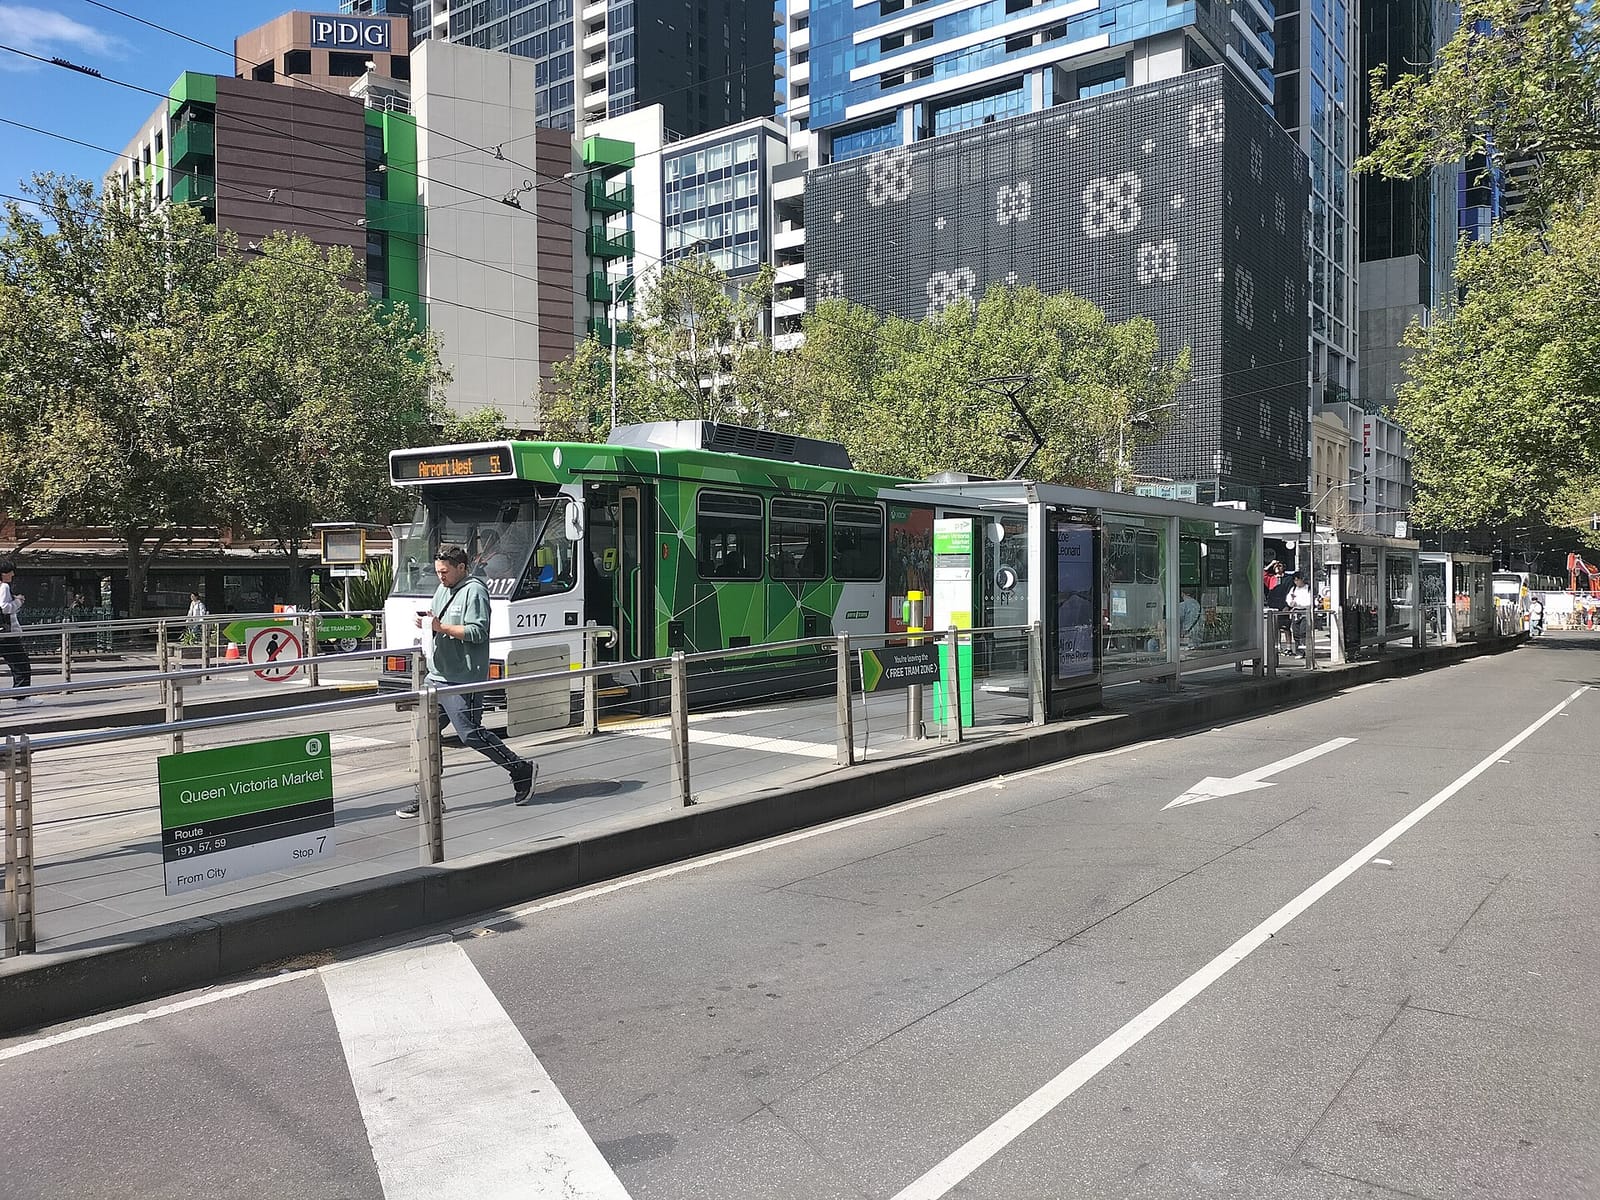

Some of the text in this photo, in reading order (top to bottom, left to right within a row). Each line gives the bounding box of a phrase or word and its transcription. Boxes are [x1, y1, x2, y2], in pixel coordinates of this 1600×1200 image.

[316, 21, 385, 46] PDG
[418, 460, 449, 478] Airport
[451, 458, 473, 475] West
[964, 569, 970, 578] 7
[486, 578, 515, 595] 2117
[516, 613, 547, 628] 2117
[894, 653, 929, 664] You're leaving the
[889, 663, 934, 678] FREE TRAM ZONE
[180, 768, 324, 804] Queen Victoria Market
[174, 827, 204, 840] Route
[198, 841, 212, 852] 57,
[214, 838, 227, 848] 59
[292, 836, 327, 860] Stop 7
[177, 867, 227, 886] From City
